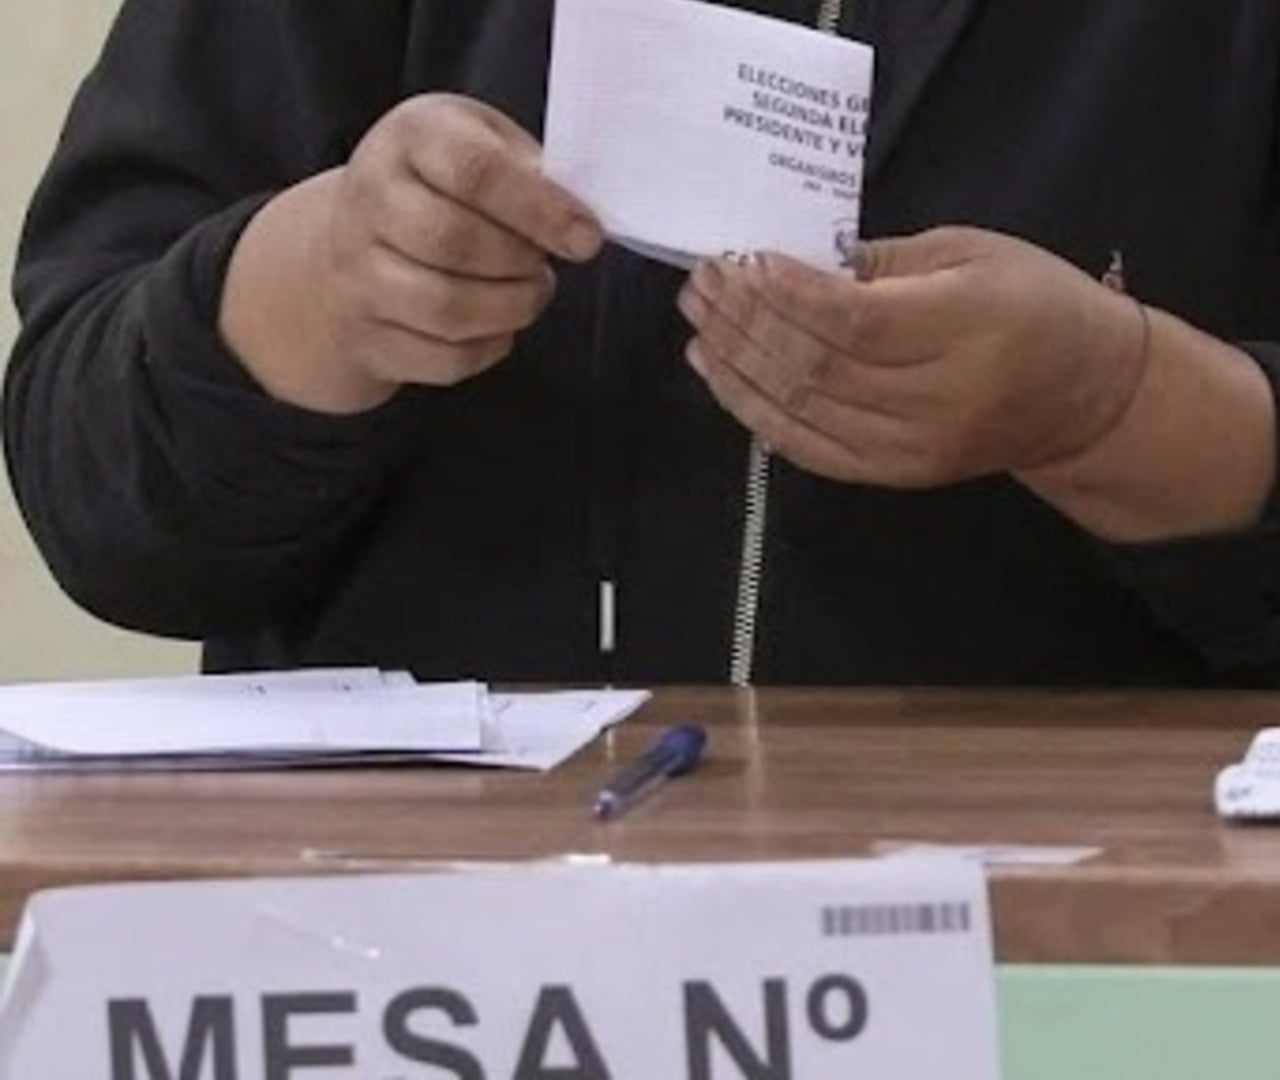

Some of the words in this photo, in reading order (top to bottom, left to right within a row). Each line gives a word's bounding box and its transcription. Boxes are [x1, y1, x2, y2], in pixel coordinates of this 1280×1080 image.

[737, 63, 841, 109] ELECCIONES
[752, 90, 833, 129] SEGUNDA
[723, 104, 825, 151] PRESIDENTE
[829, 136, 840, 154] Y
[106, 983, 614, 1080] MESA
